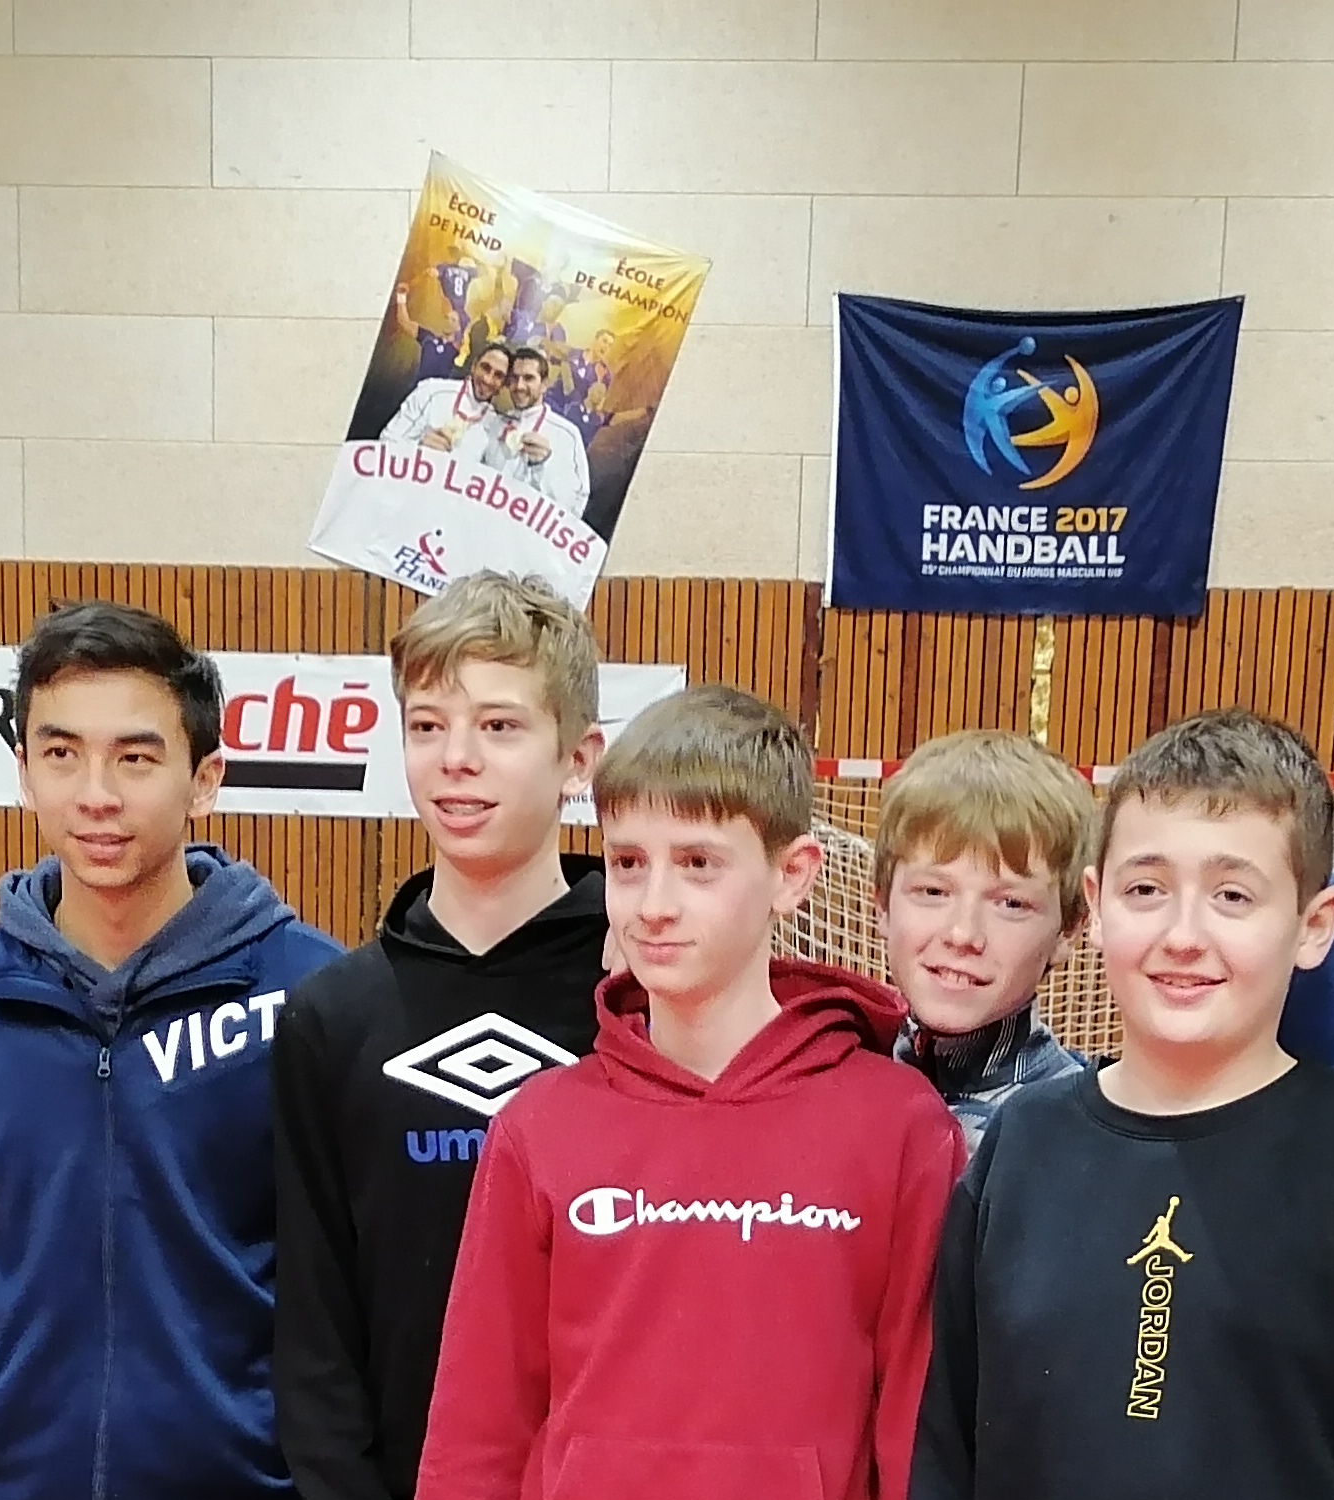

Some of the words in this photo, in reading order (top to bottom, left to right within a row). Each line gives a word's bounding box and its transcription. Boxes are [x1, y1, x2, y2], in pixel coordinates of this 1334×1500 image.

[448, 192, 497, 228] ÉCOLE
[429, 213, 450, 233] DE
[453, 222, 502, 252] HAND
[615, 257, 666, 292] ÉCOLE
[574, 270, 596, 288] DE
[598, 279, 689, 324] CHAMPION
[353, 445, 435, 485] Club
[444, 459, 595, 566] Labellisé
[923, 504, 1048, 533] FRANCE
[1055, 507, 1128, 533] 2017
[921, 532, 1126, 565] HANDBALL
[938, 565, 1005, 578] CHAMPIONNAT
[1057, 566, 1106, 579] MASCULIN
[141, 990, 286, 1084] VICT
[568, 1187, 862, 1241] Champion
[1127, 1255, 1174, 1419] JORDAN
